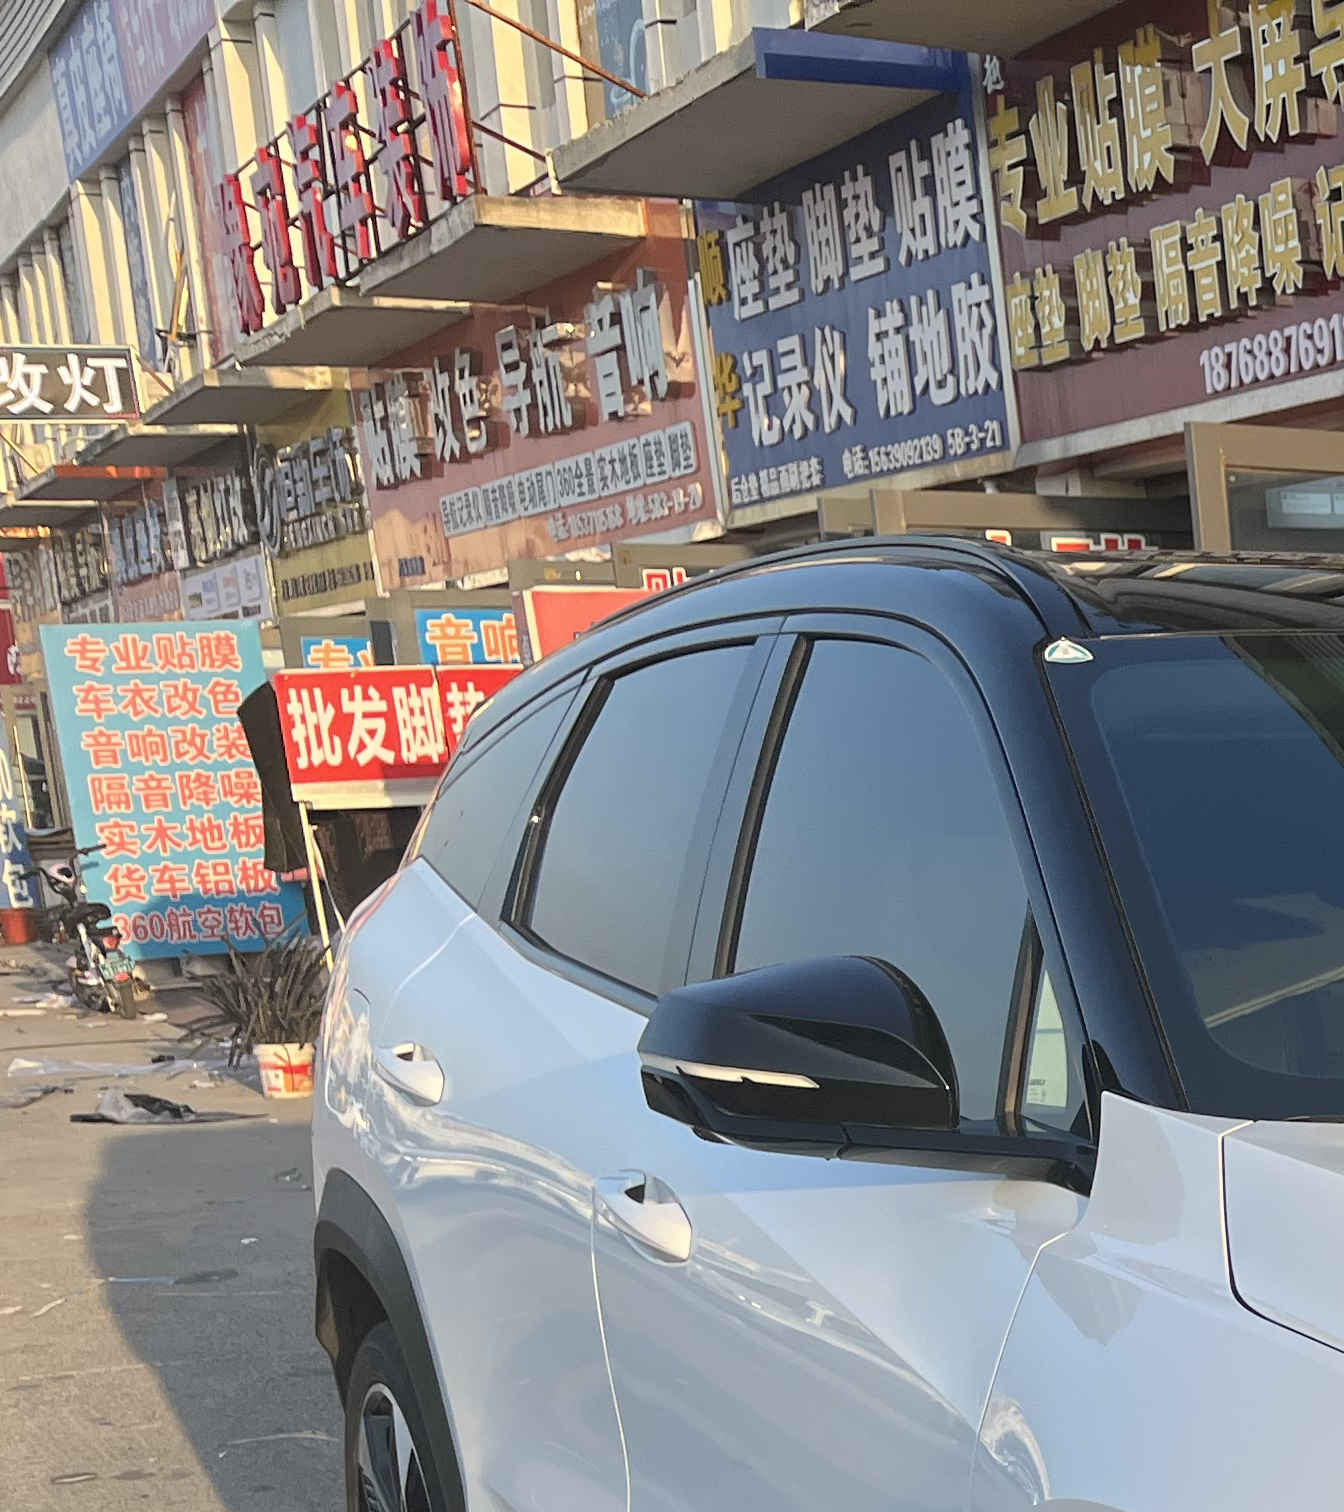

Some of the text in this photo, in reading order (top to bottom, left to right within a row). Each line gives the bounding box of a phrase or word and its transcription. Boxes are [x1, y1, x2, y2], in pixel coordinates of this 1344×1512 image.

[989, 23, 1175, 236] 专业贴膜
[726, 118, 984, 322] 座垫 脚垫 贴膜
[1009, 264, 1071, 369] 座垫
[1075, 236, 1146, 351] 脚垫
[1151, 177, 1303, 332] 隔音降噪
[0, 352, 129, 415] 改灯
[741, 274, 999, 448] 记录仪 铺地胶
[64, 632, 243, 673] 专业贴膜
[73, 680, 242, 721] 车衣改色
[81, 726, 252, 768] 音响改装
[88, 772, 262, 814] 隔音降噪
[96, 815, 265, 857] 实木地板
[104, 859, 281, 904] 货车铝板
